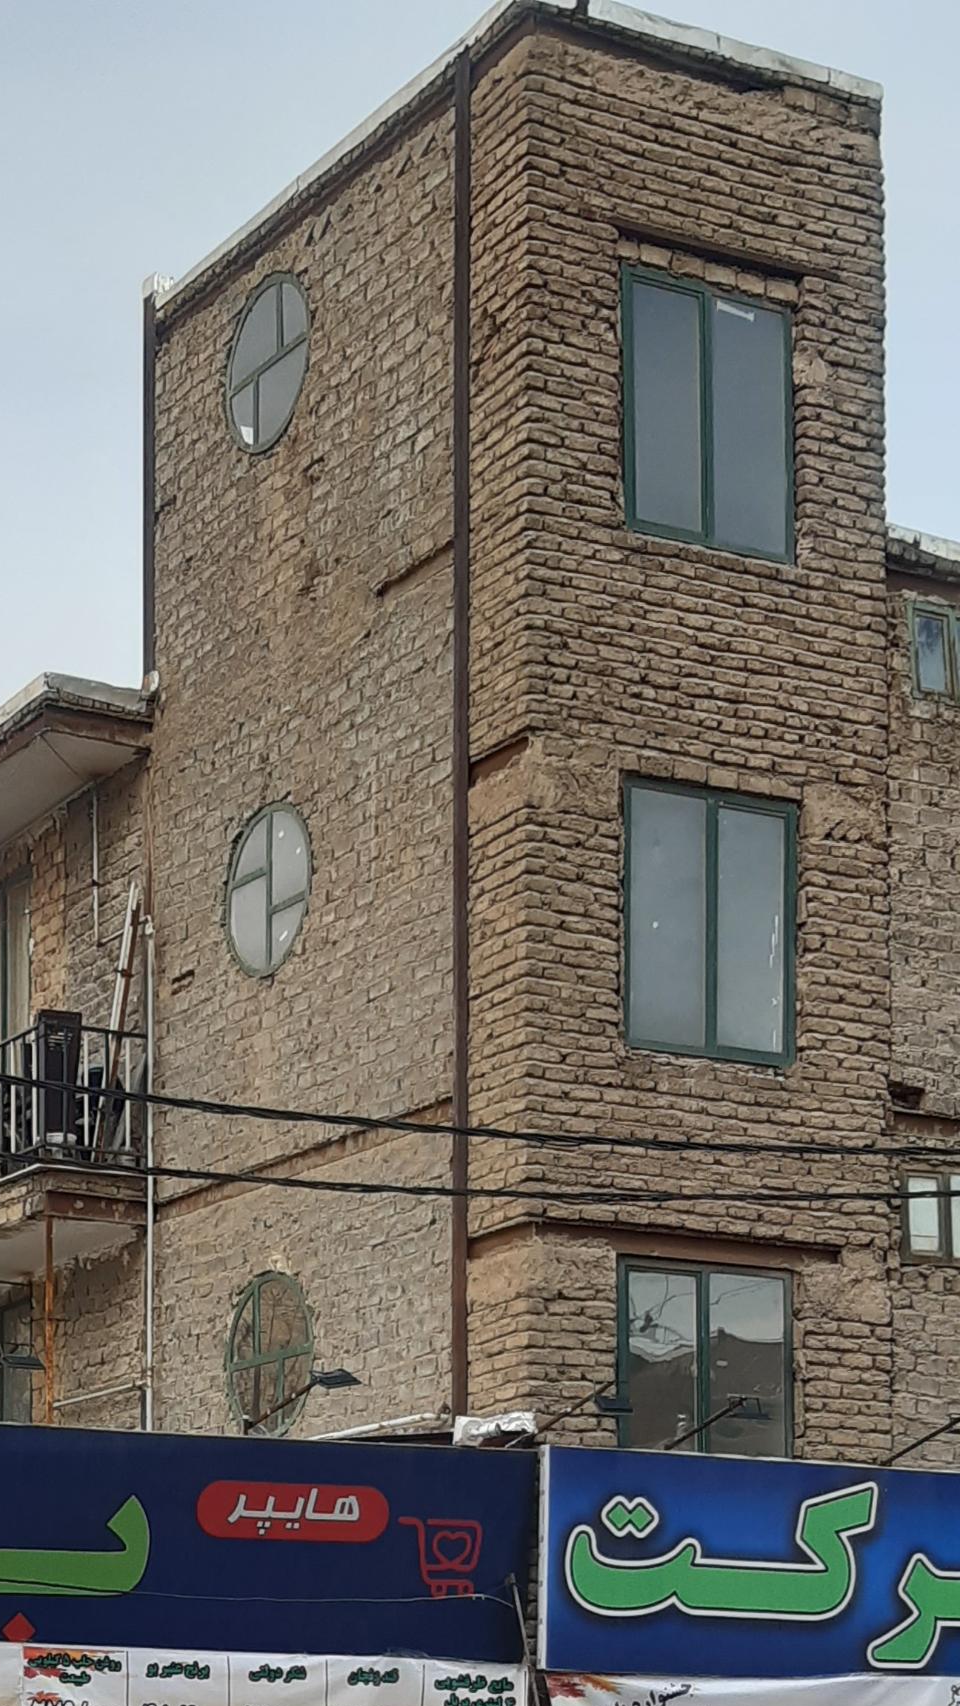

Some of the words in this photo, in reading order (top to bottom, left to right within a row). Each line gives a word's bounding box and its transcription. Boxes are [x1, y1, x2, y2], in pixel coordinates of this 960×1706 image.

[228, 1487, 360, 1536] هایپر
[562, 1481, 960, 1669] رکت
[184, 1661, 210, 1680] برنج
[248, 1663, 283, 1682] دولتی
[487, 1676, 515, 1694] مایع
